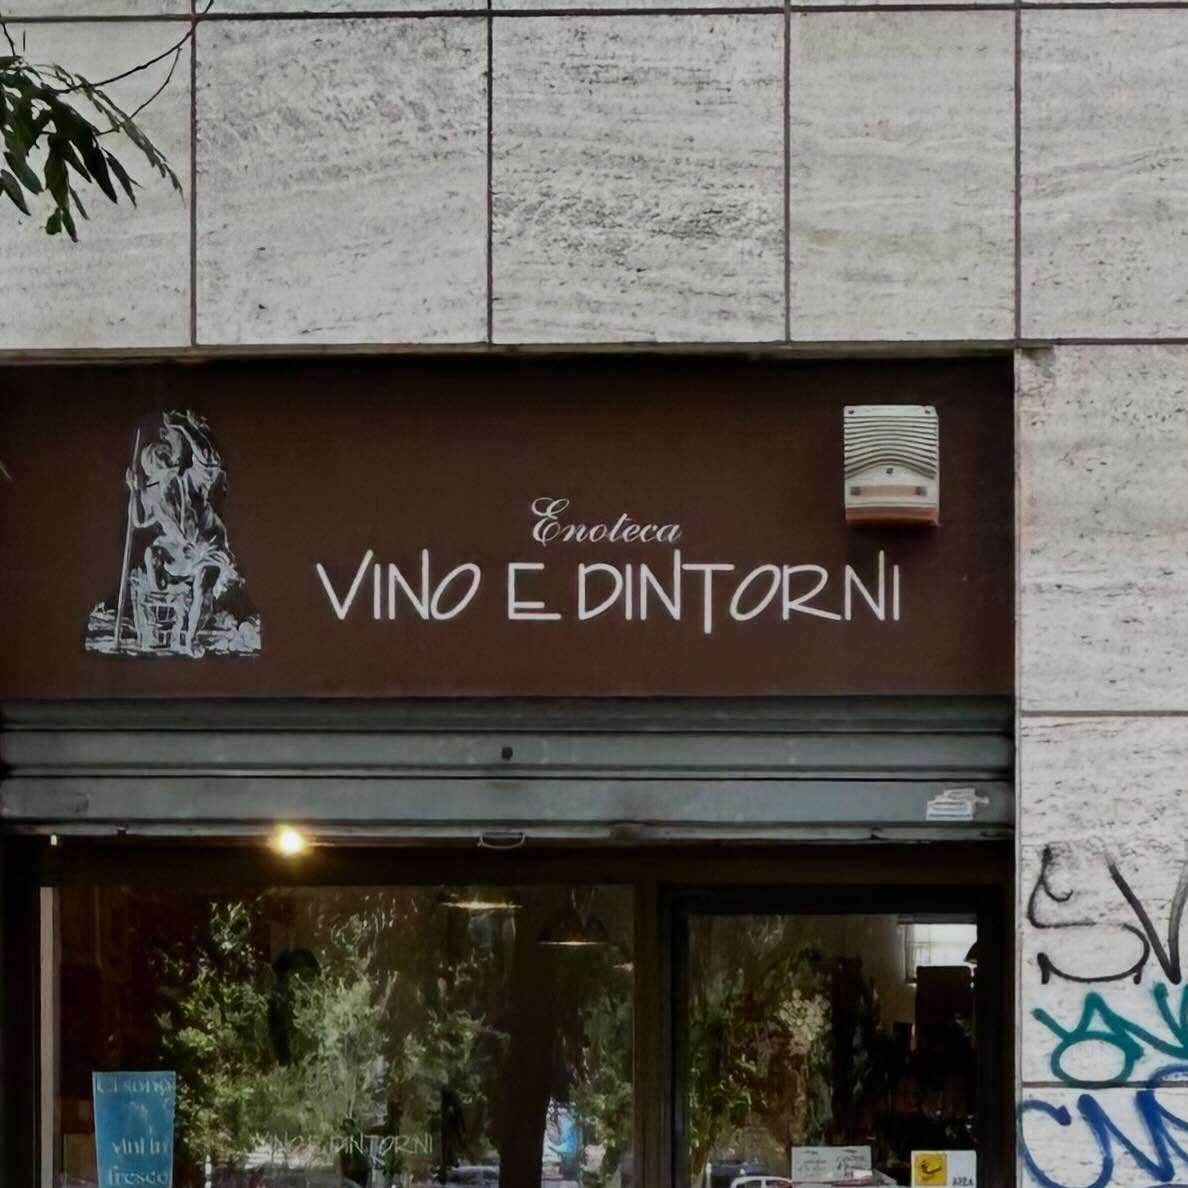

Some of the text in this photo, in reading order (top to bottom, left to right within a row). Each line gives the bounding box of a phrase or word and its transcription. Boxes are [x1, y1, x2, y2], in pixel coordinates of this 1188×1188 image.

[531, 497, 682, 546] Enoteca
[316, 549, 900, 634] VINO E DINTORNI
[330, 1131, 433, 1155] DINTORNI
